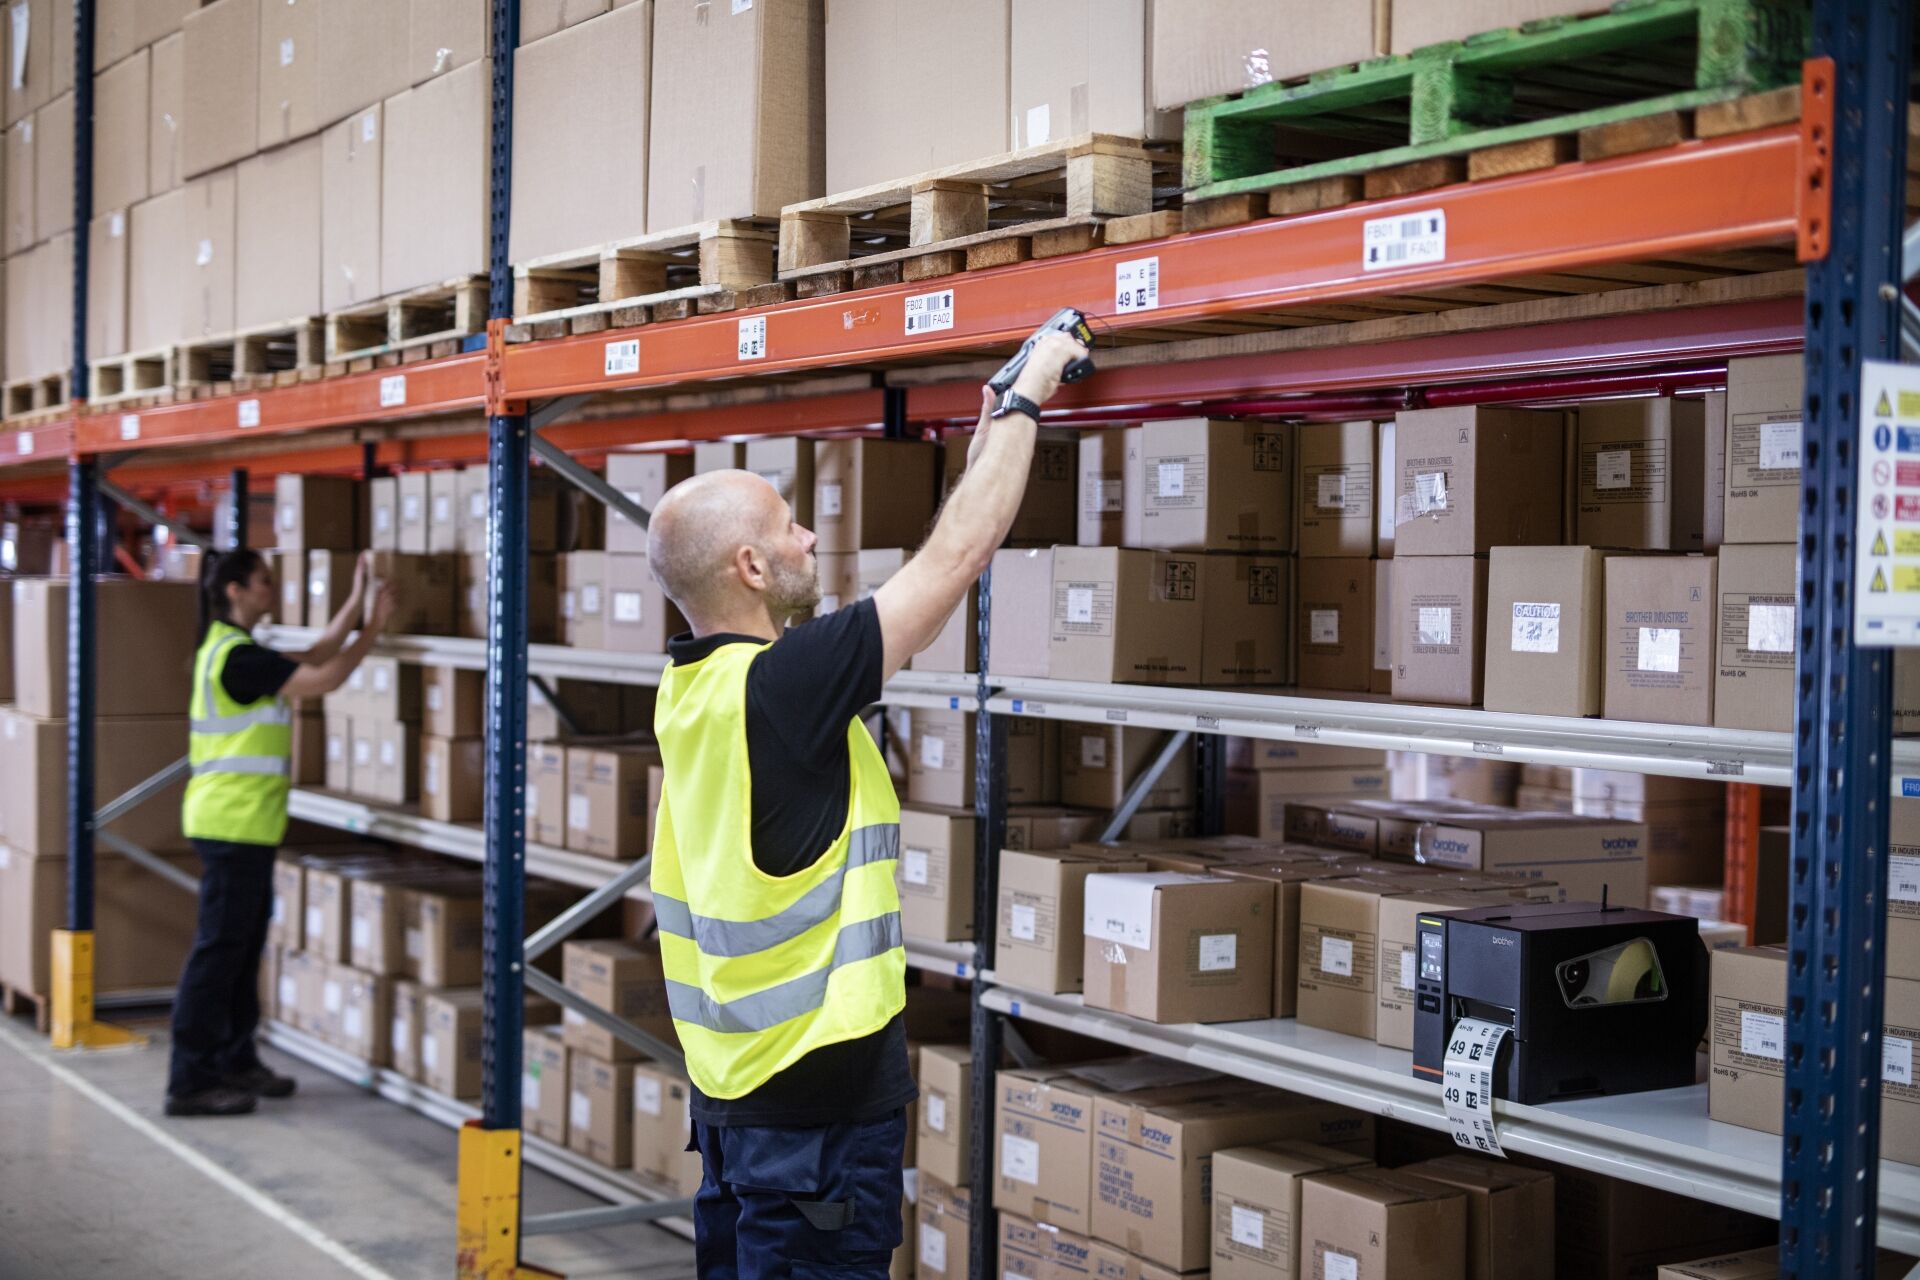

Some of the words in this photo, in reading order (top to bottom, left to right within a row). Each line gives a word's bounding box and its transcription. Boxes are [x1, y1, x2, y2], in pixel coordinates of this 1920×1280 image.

[1367, 223, 1393, 238] FB01
[1410, 240, 1438, 256] FA01
[1139, 268, 1145, 279] E
[906, 299, 923, 311] FB02
[1118, 291, 1131, 307] 49
[932, 313, 950, 325] FA02
[1460, 430, 1468, 442] A
[1730, 490, 1748, 498] RoHS
[1749, 489, 1759, 497] OK
[1692, 588, 1699, 599] A
[1749, 596, 1773, 604] BROTHER
[1515, 605, 1559, 618] CAUTION
[1625, 611, 1653, 624] BROTHER
[1654, 611, 1688, 624] INDUSTRIES
[1720, 670, 1736, 678] RoHS
[1737, 670, 1747, 678] OK
[1433, 838, 1470, 854] brother
[1602, 837, 1639, 850] brother
[1493, 936, 1514, 946] brother
[1739, 1002, 1762, 1013] BROTHER
[1480, 1027, 1489, 1037] E
[1450, 1039, 1466, 1055] 49
[1470, 1044, 1482, 1059] 12
[1470, 1073, 1476, 1083] E
[1714, 1067, 1729, 1077] RoHS
[1729, 1070, 1739, 1079] OK
[1445, 1087, 1460, 1103] 49
[1466, 1092, 1477, 1108] 12
[1473, 1120, 1480, 1130] E
[1140, 1123, 1173, 1145] brother
[1455, 1131, 1471, 1145] 49
[1475, 1136, 1489, 1150] 12
[1371, 1233, 1379, 1248] A
